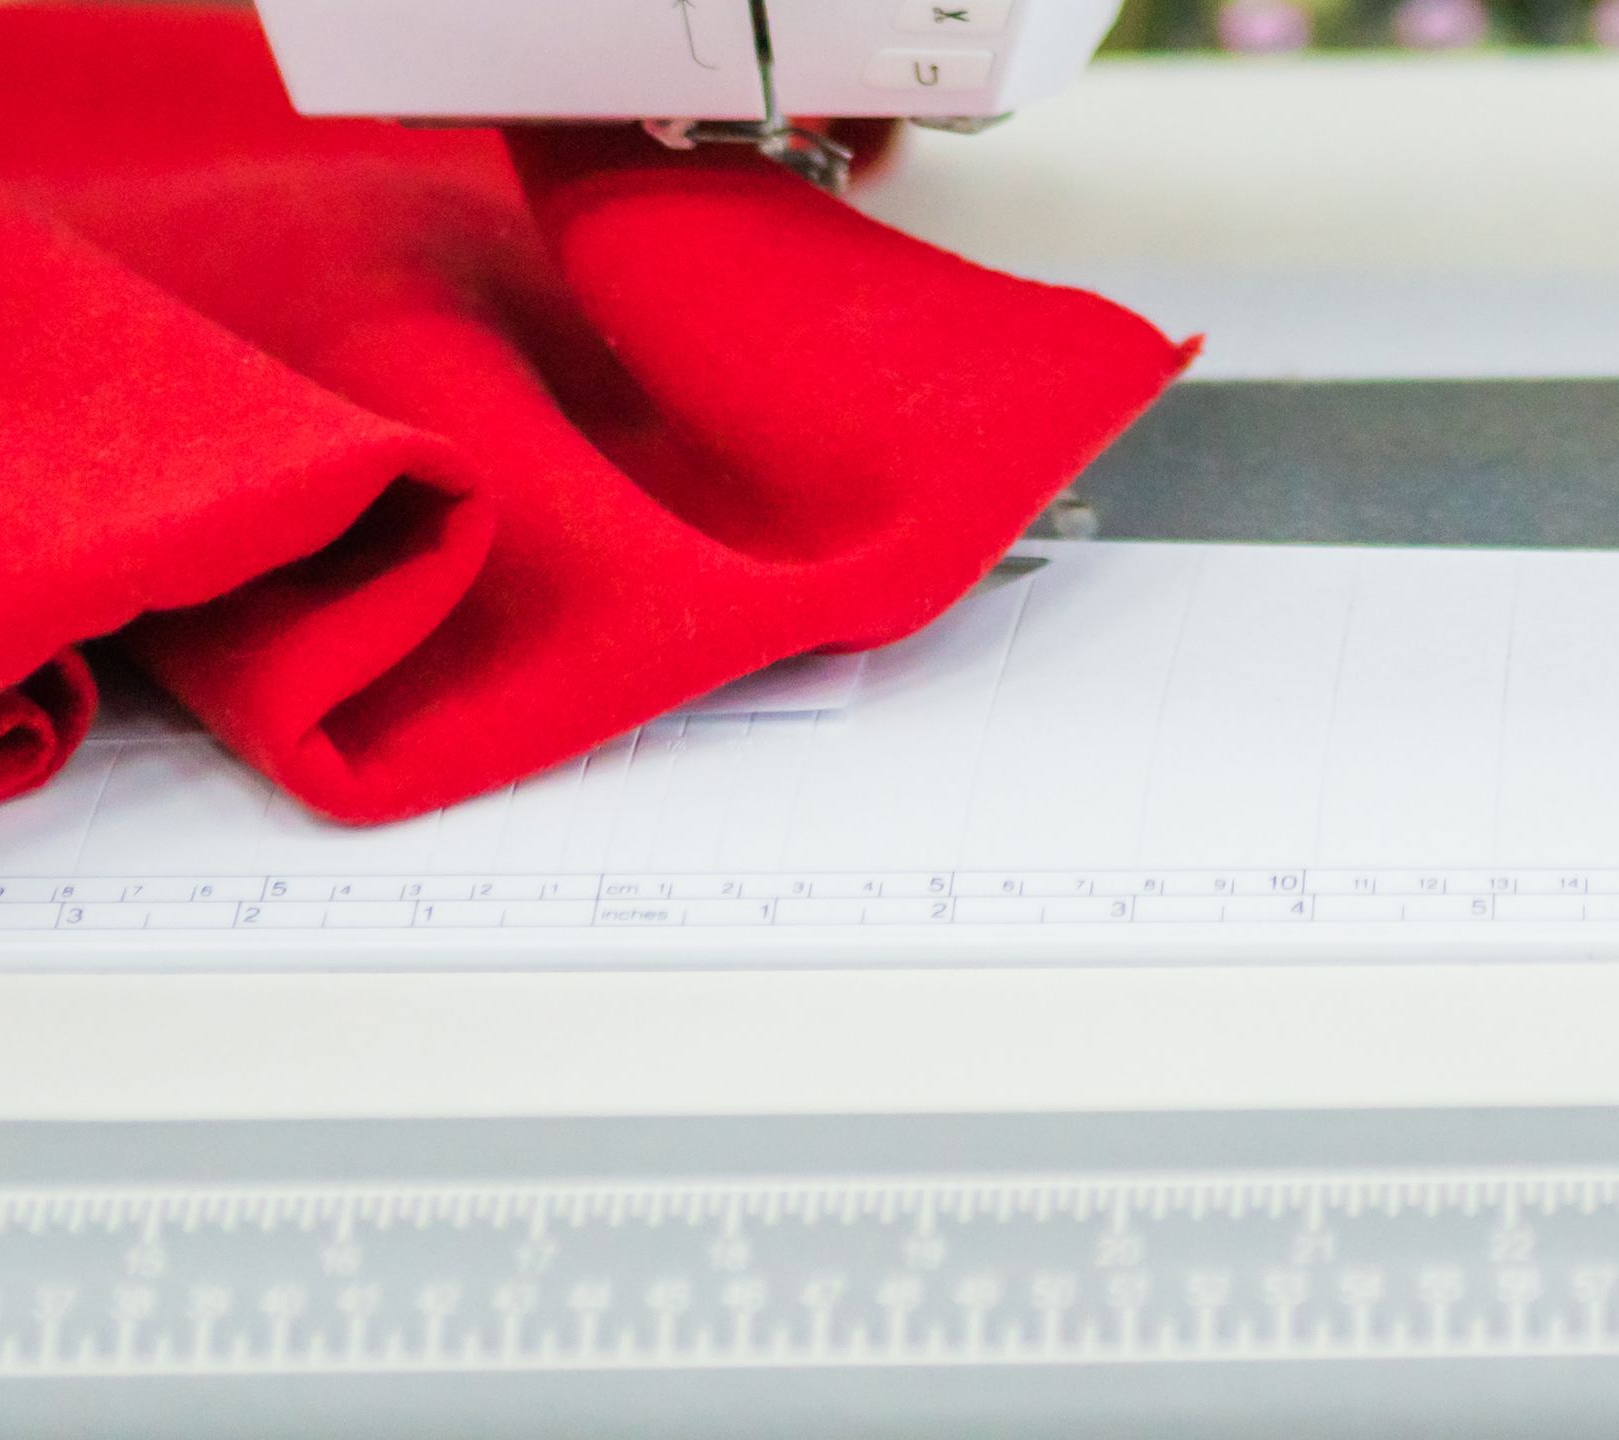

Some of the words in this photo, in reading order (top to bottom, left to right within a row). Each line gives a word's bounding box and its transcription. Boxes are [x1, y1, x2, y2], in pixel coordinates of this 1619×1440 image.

[61, 886, 75, 898] 8
[199, 886, 213, 897] 6
[270, 881, 287, 897] 5
[340, 884, 351, 896] 4
[409, 884, 422, 896] 3
[480, 883, 493, 896] 2
[606, 883, 639, 896] cm
[721, 882, 735, 894] 2
[792, 882, 805, 894] 3
[862, 882, 873, 893] 4
[930, 877, 945, 892] 5
[1002, 880, 1015, 892] 6
[1144, 879, 1156, 891] 8
[1214, 878, 1226, 891] 9
[1270, 875, 1297, 891] 10
[1353, 878, 1368, 890] 11
[1420, 878, 1439, 890] 12
[1489, 878, 1509, 890] 13
[1559, 878, 1578, 889] 14
[66, 907, 83, 924] 3
[243, 907, 261, 923] 2
[931, 902, 947, 919] 2
[1110, 901, 1127, 918] 3
[1291, 900, 1304, 915] 4
[1471, 900, 1487, 916] 5
